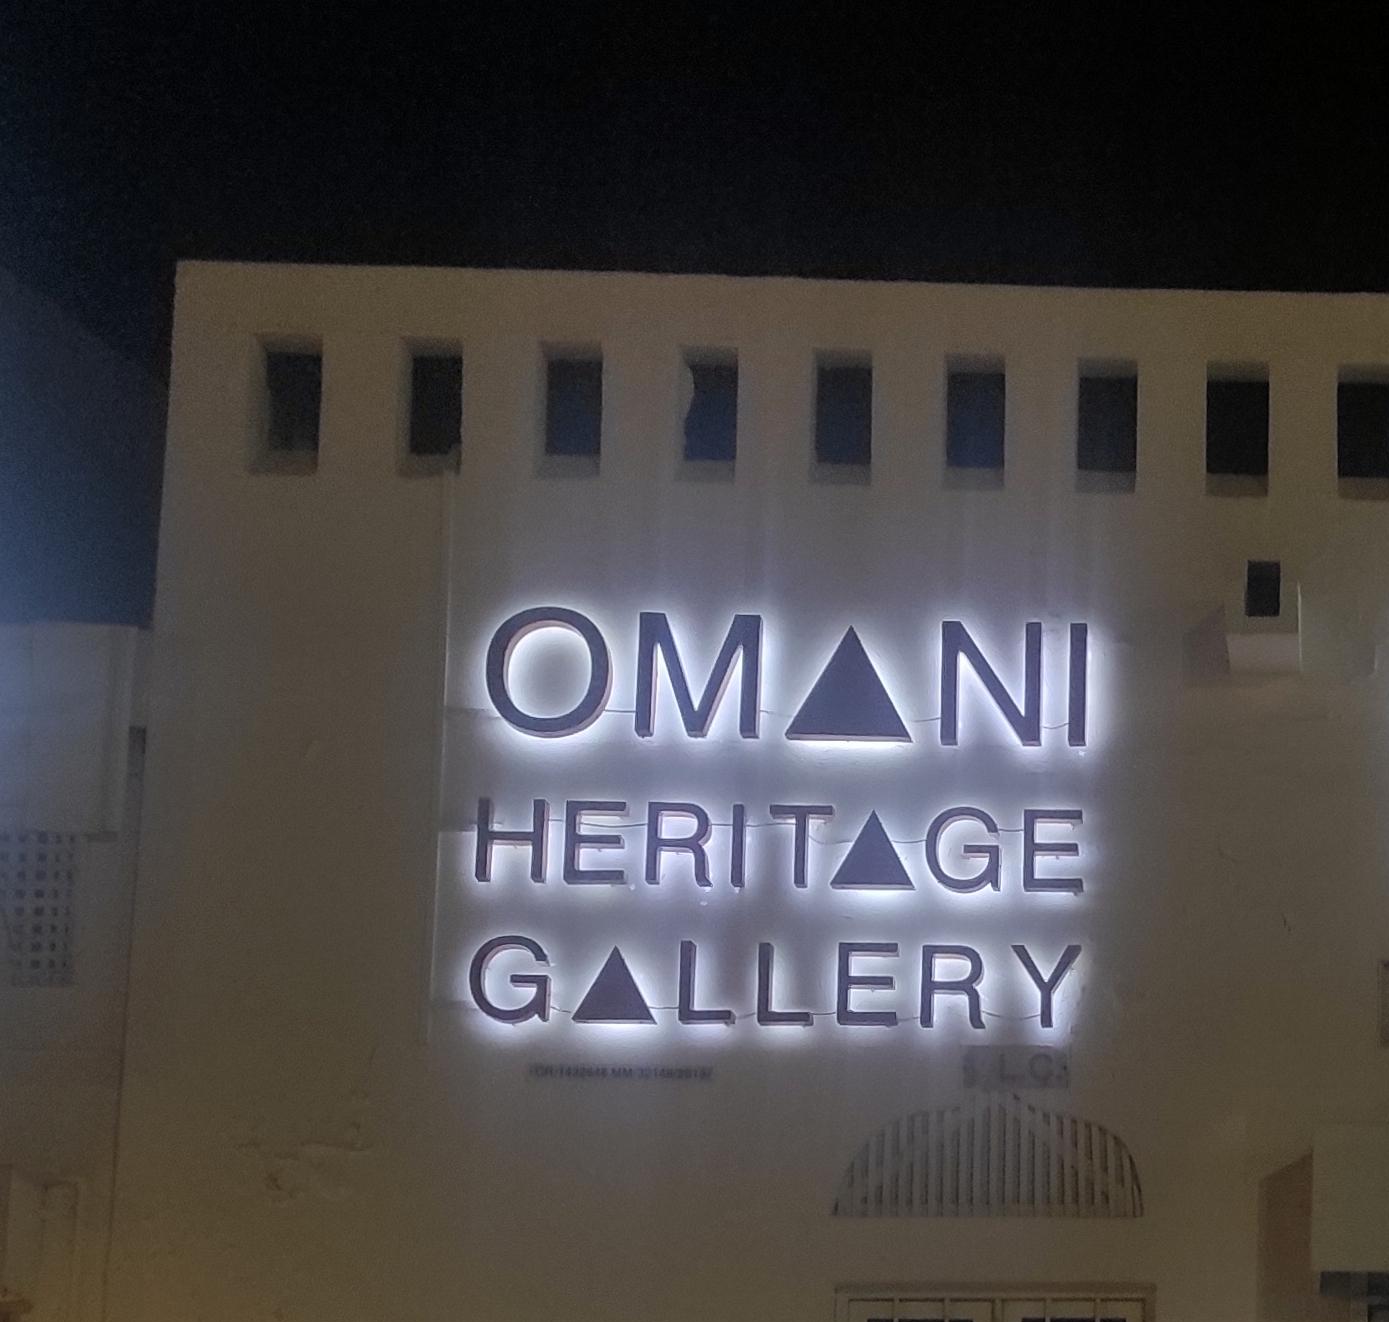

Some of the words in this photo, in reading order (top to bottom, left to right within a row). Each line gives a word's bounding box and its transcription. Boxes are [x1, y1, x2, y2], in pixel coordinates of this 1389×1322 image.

[485, 605, 1088, 748] OMANI
[473, 797, 1085, 896] HERITAGE
[468, 934, 1083, 1030] GALLERY
